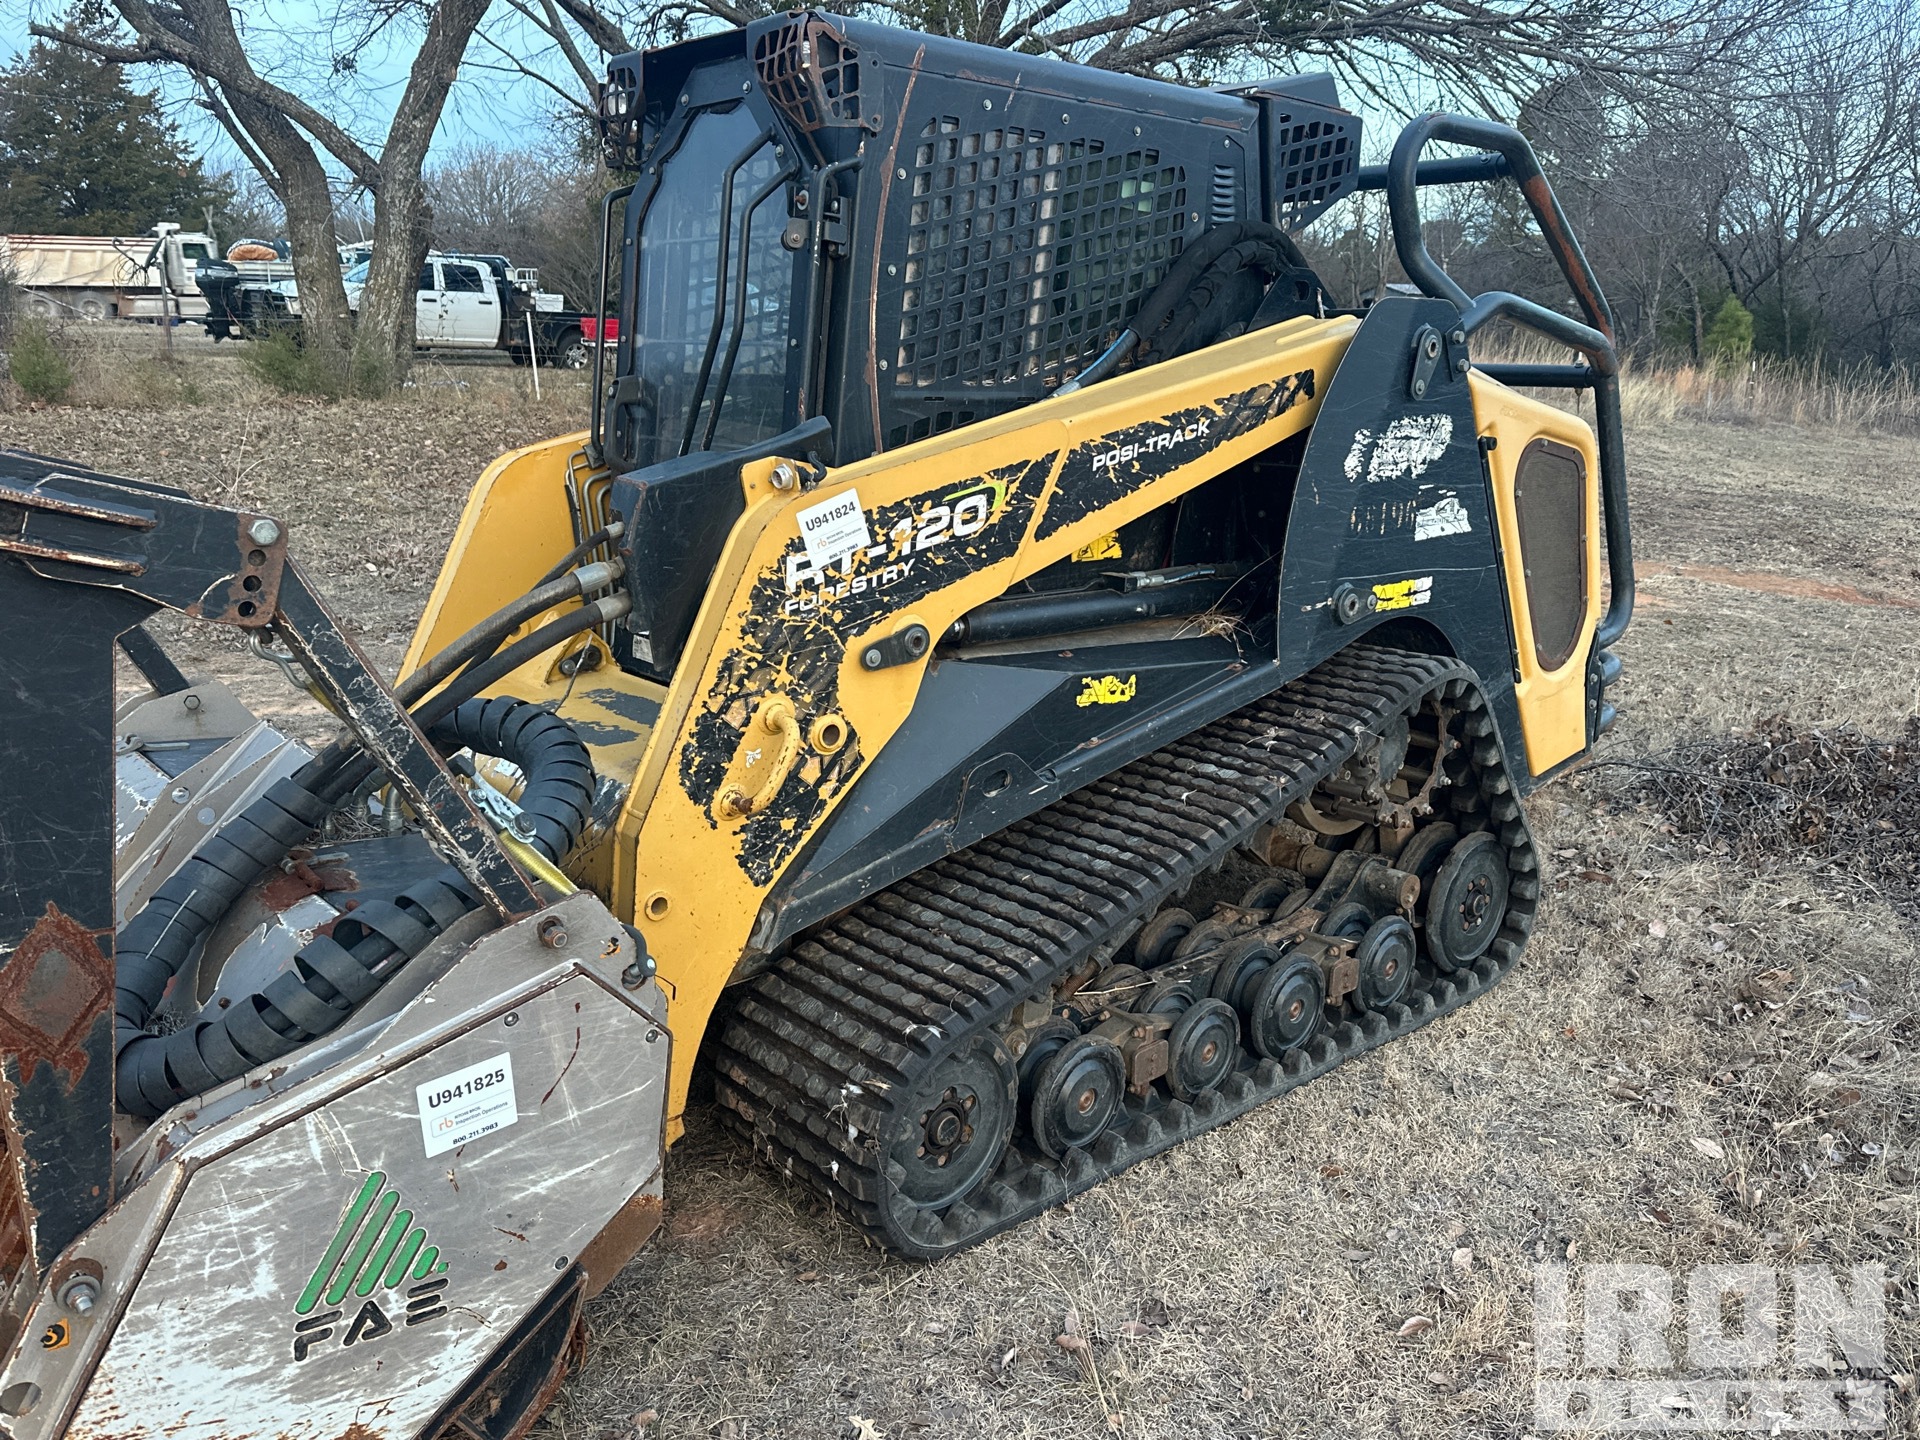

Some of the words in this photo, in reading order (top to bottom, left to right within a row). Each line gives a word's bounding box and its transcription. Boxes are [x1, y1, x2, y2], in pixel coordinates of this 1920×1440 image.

[1092, 419, 1211, 472] POSI-TRACK
[805, 501, 857, 531] U941824
[785, 558, 916, 616] FORESTRY
[428, 1068, 505, 1108] U941825
[452, 1122, 499, 1144] 800.211.3983
[455, 1112, 482, 1126] Inspection
[481, 1101, 508, 1116] Operations
[294, 1278, 449, 1361] FAE
